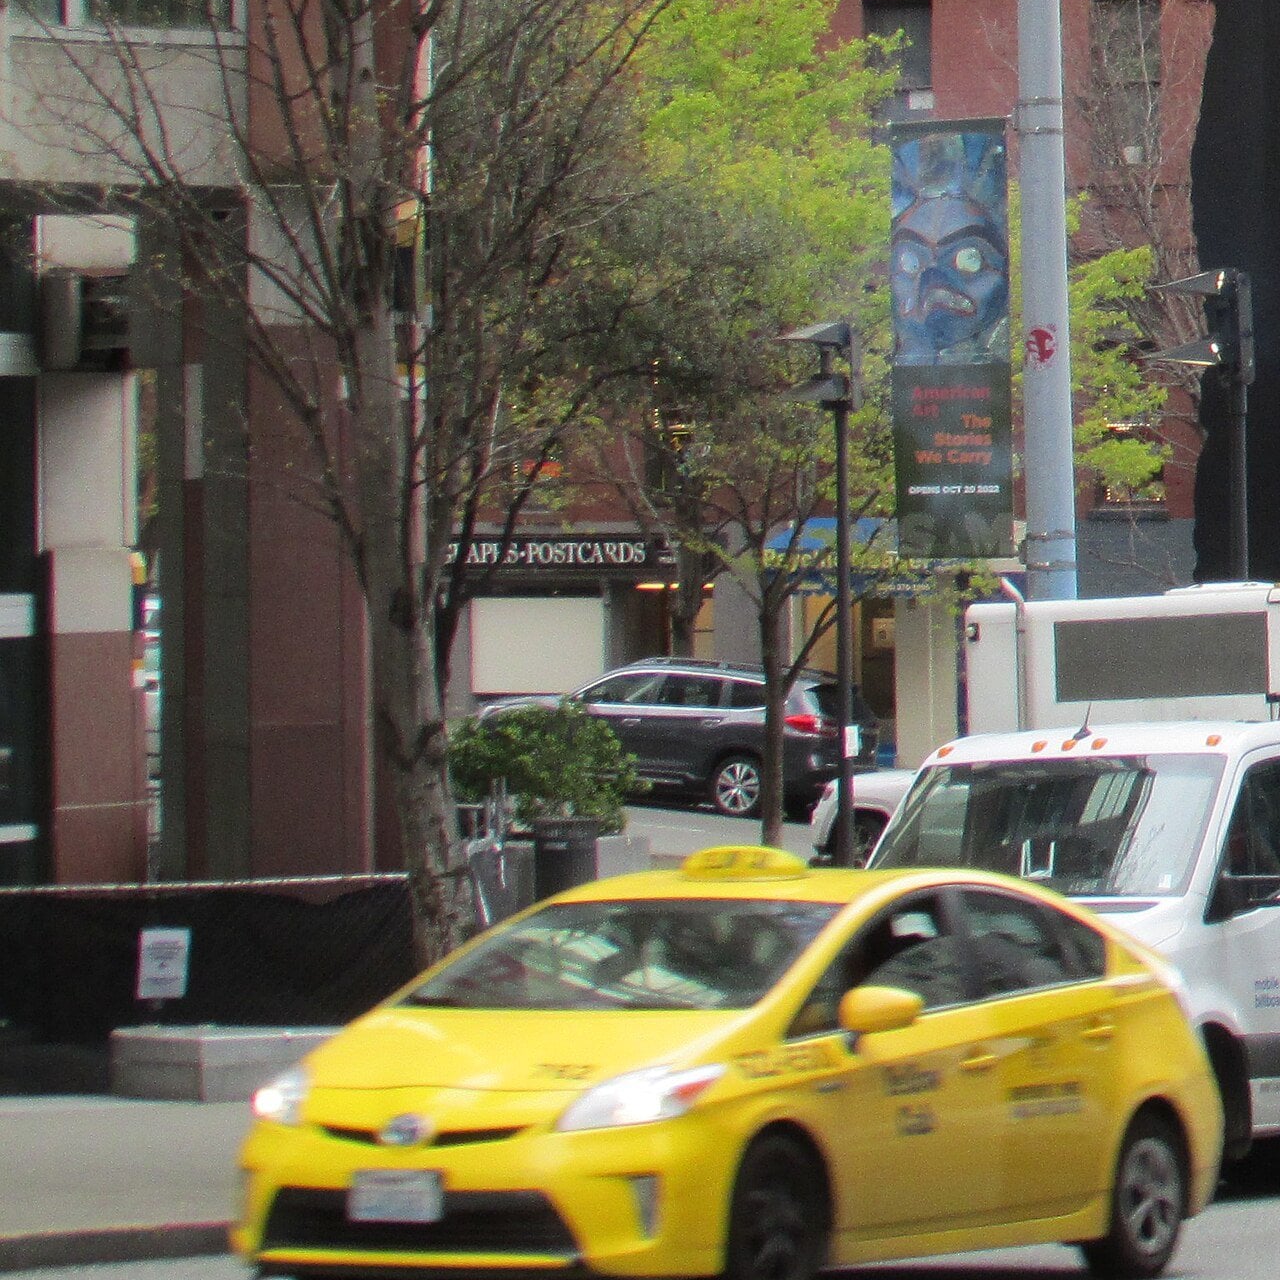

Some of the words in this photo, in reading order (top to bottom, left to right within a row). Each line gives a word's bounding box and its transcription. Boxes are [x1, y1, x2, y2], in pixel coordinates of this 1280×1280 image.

[908, 485, 940, 495] OPENS
[942, 485, 961, 494] OCT
[525, 542, 646, 564] POSTCARDS
